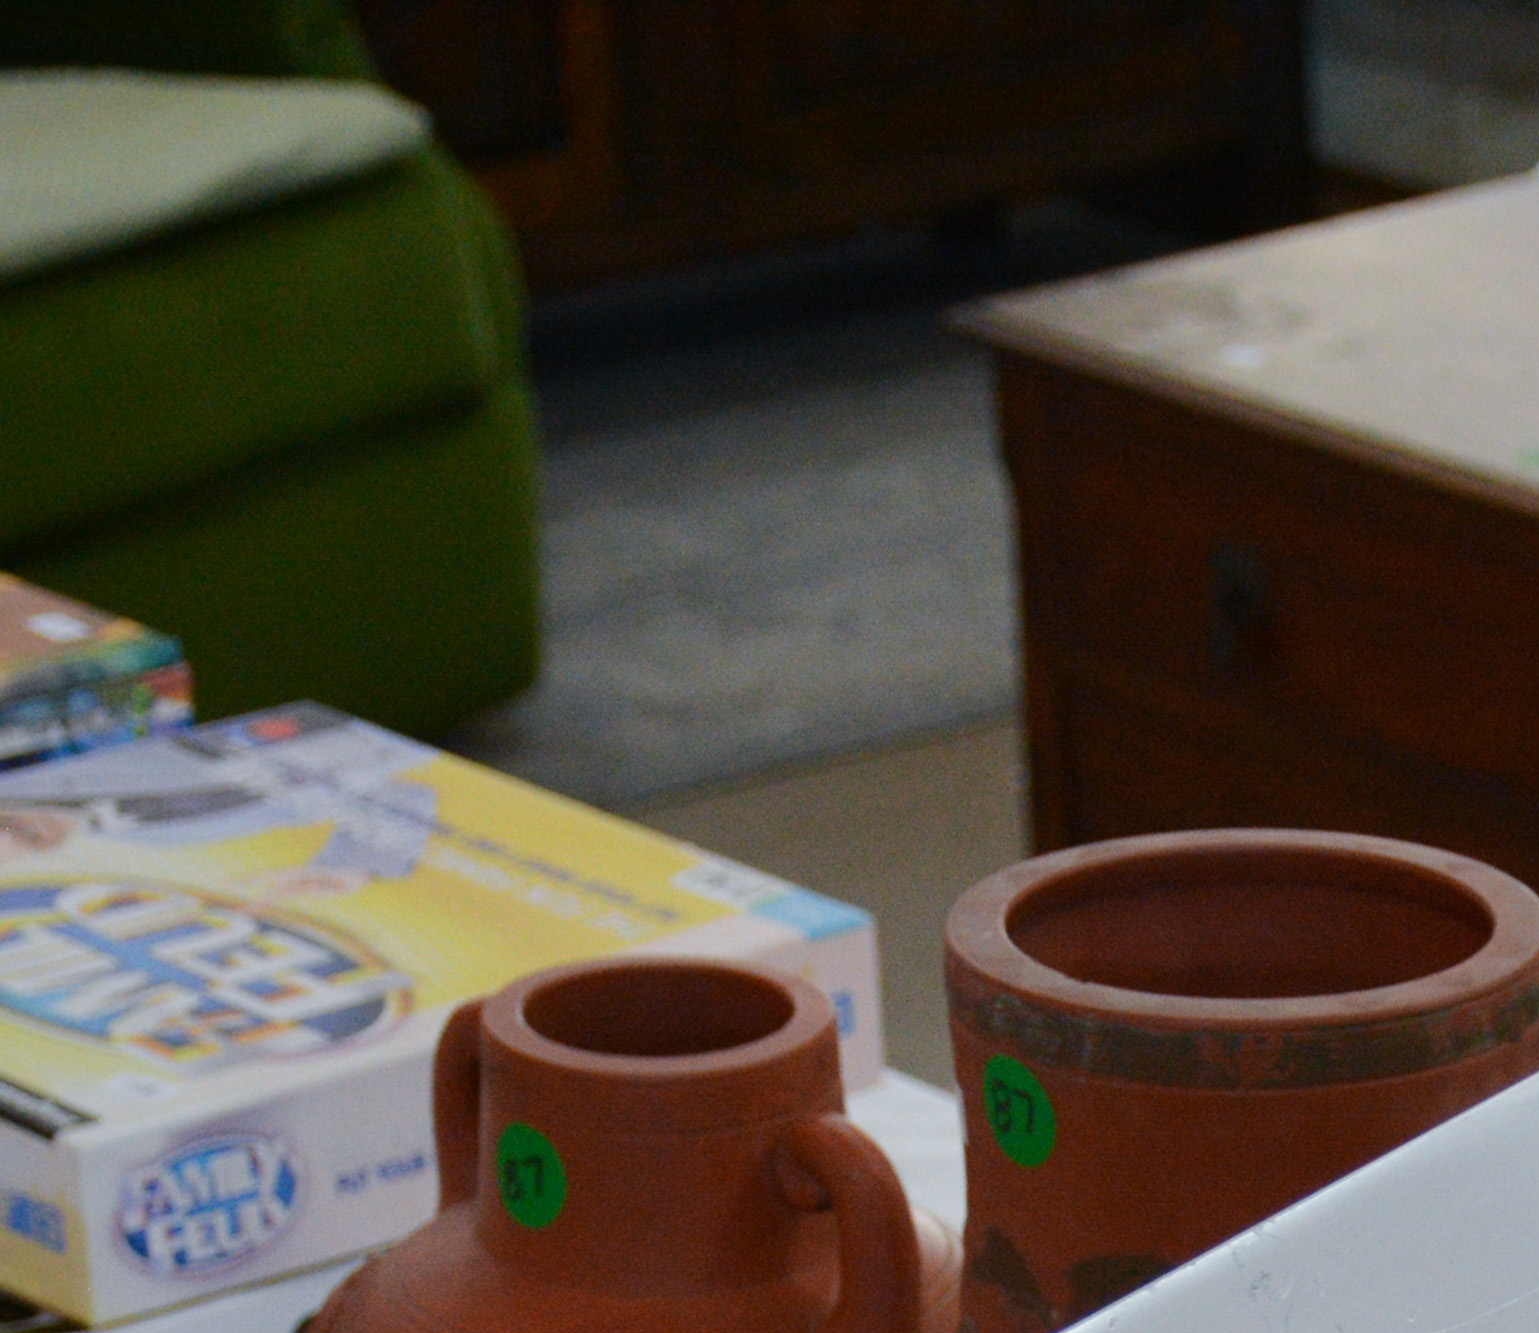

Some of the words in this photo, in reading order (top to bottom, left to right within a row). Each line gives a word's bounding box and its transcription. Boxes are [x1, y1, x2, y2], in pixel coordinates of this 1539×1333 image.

[0, 920, 332, 1078] FAMIL
[58, 880, 413, 1021] FEUD
[120, 1142, 292, 1232] FAMILY
[150, 1196, 288, 1276] FEUD
